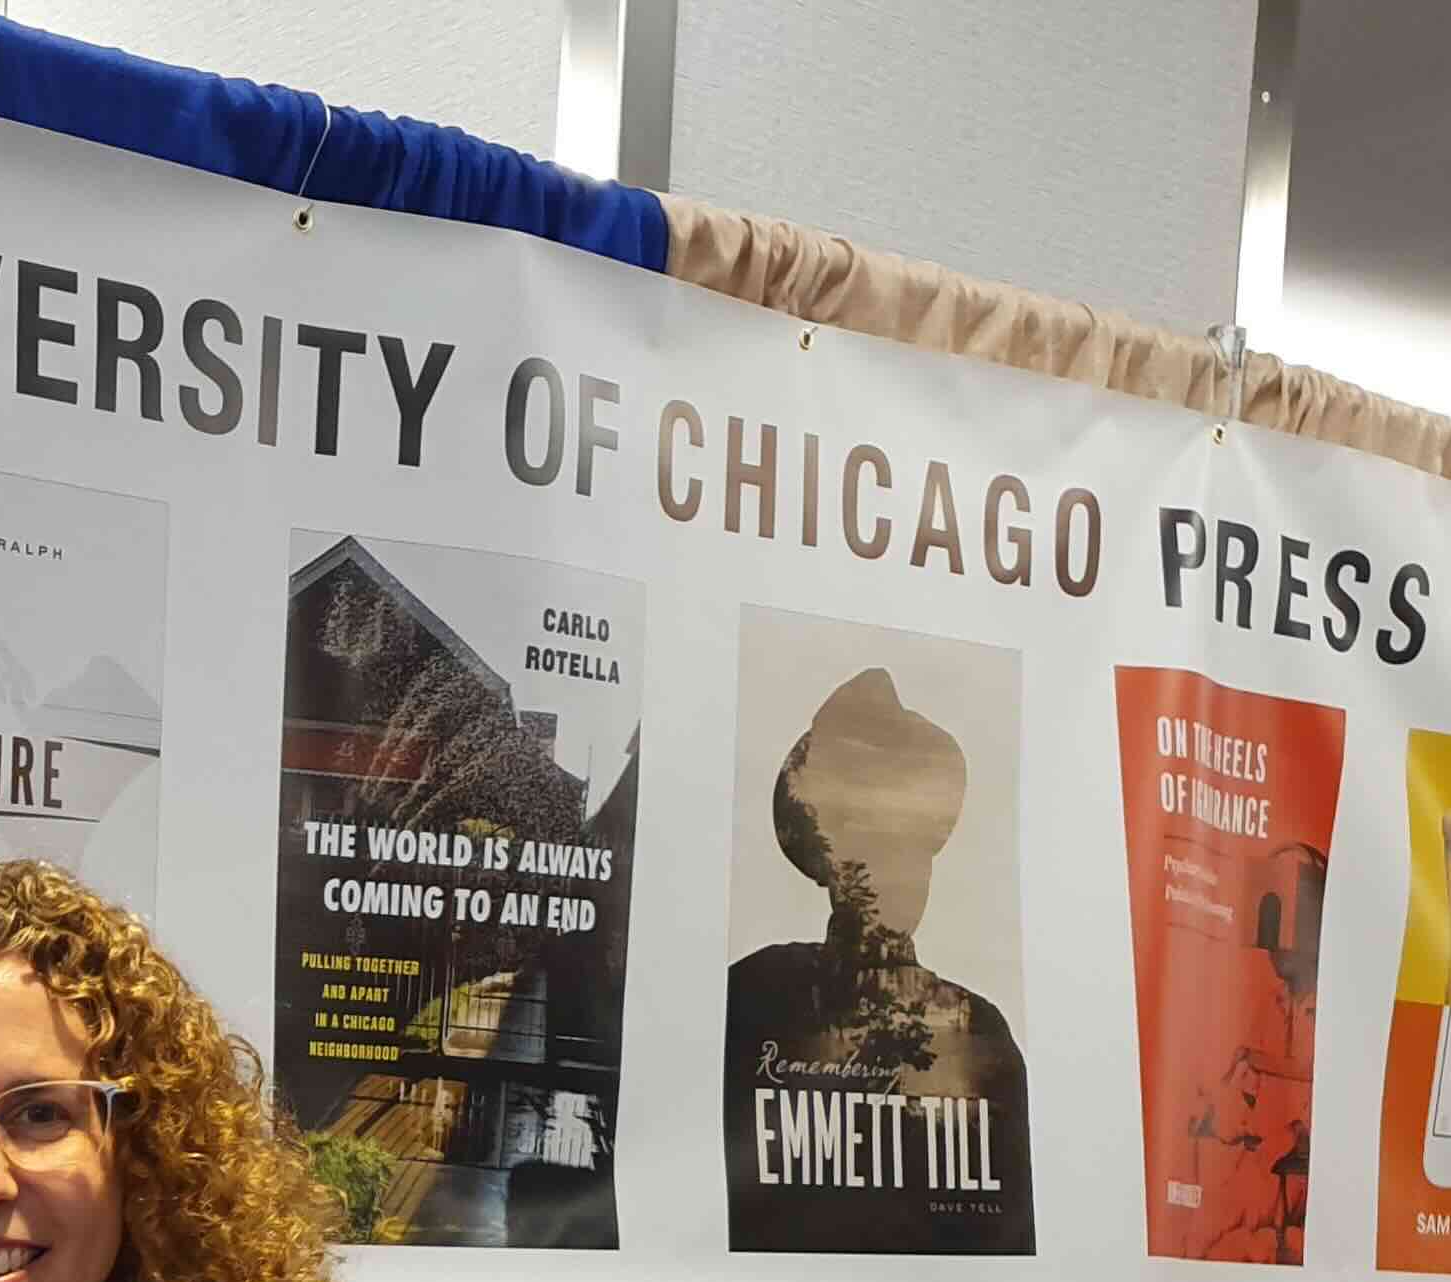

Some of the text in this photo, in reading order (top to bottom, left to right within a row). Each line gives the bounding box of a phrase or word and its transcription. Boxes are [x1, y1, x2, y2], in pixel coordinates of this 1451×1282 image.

[504, 356, 620, 497] OF
[657, 399, 1101, 598] CHICAGO
[1159, 507, 1430, 666] PRESS
[543, 608, 610, 642] CARLO
[525, 646, 620, 685] ROTELLA
[1157, 716, 1187, 757] ON
[1214, 734, 1268, 784] HEELS
[1160, 772, 1187, 814] OF
[304, 822, 612, 881] THE WORLD IS ALWAYS
[324, 879, 595, 932] COMING TO AN END
[301, 952, 420, 975] PULLING TOGETHER
[322, 984, 389, 1002] AND APART
[315, 1012, 395, 1031] IN A CHICAGO
[309, 1041, 400, 1060] NEIGHBORHOOD
[756, 1041, 900, 1102] Remembering
[755, 1088, 1001, 1190] EMMETT TILL
